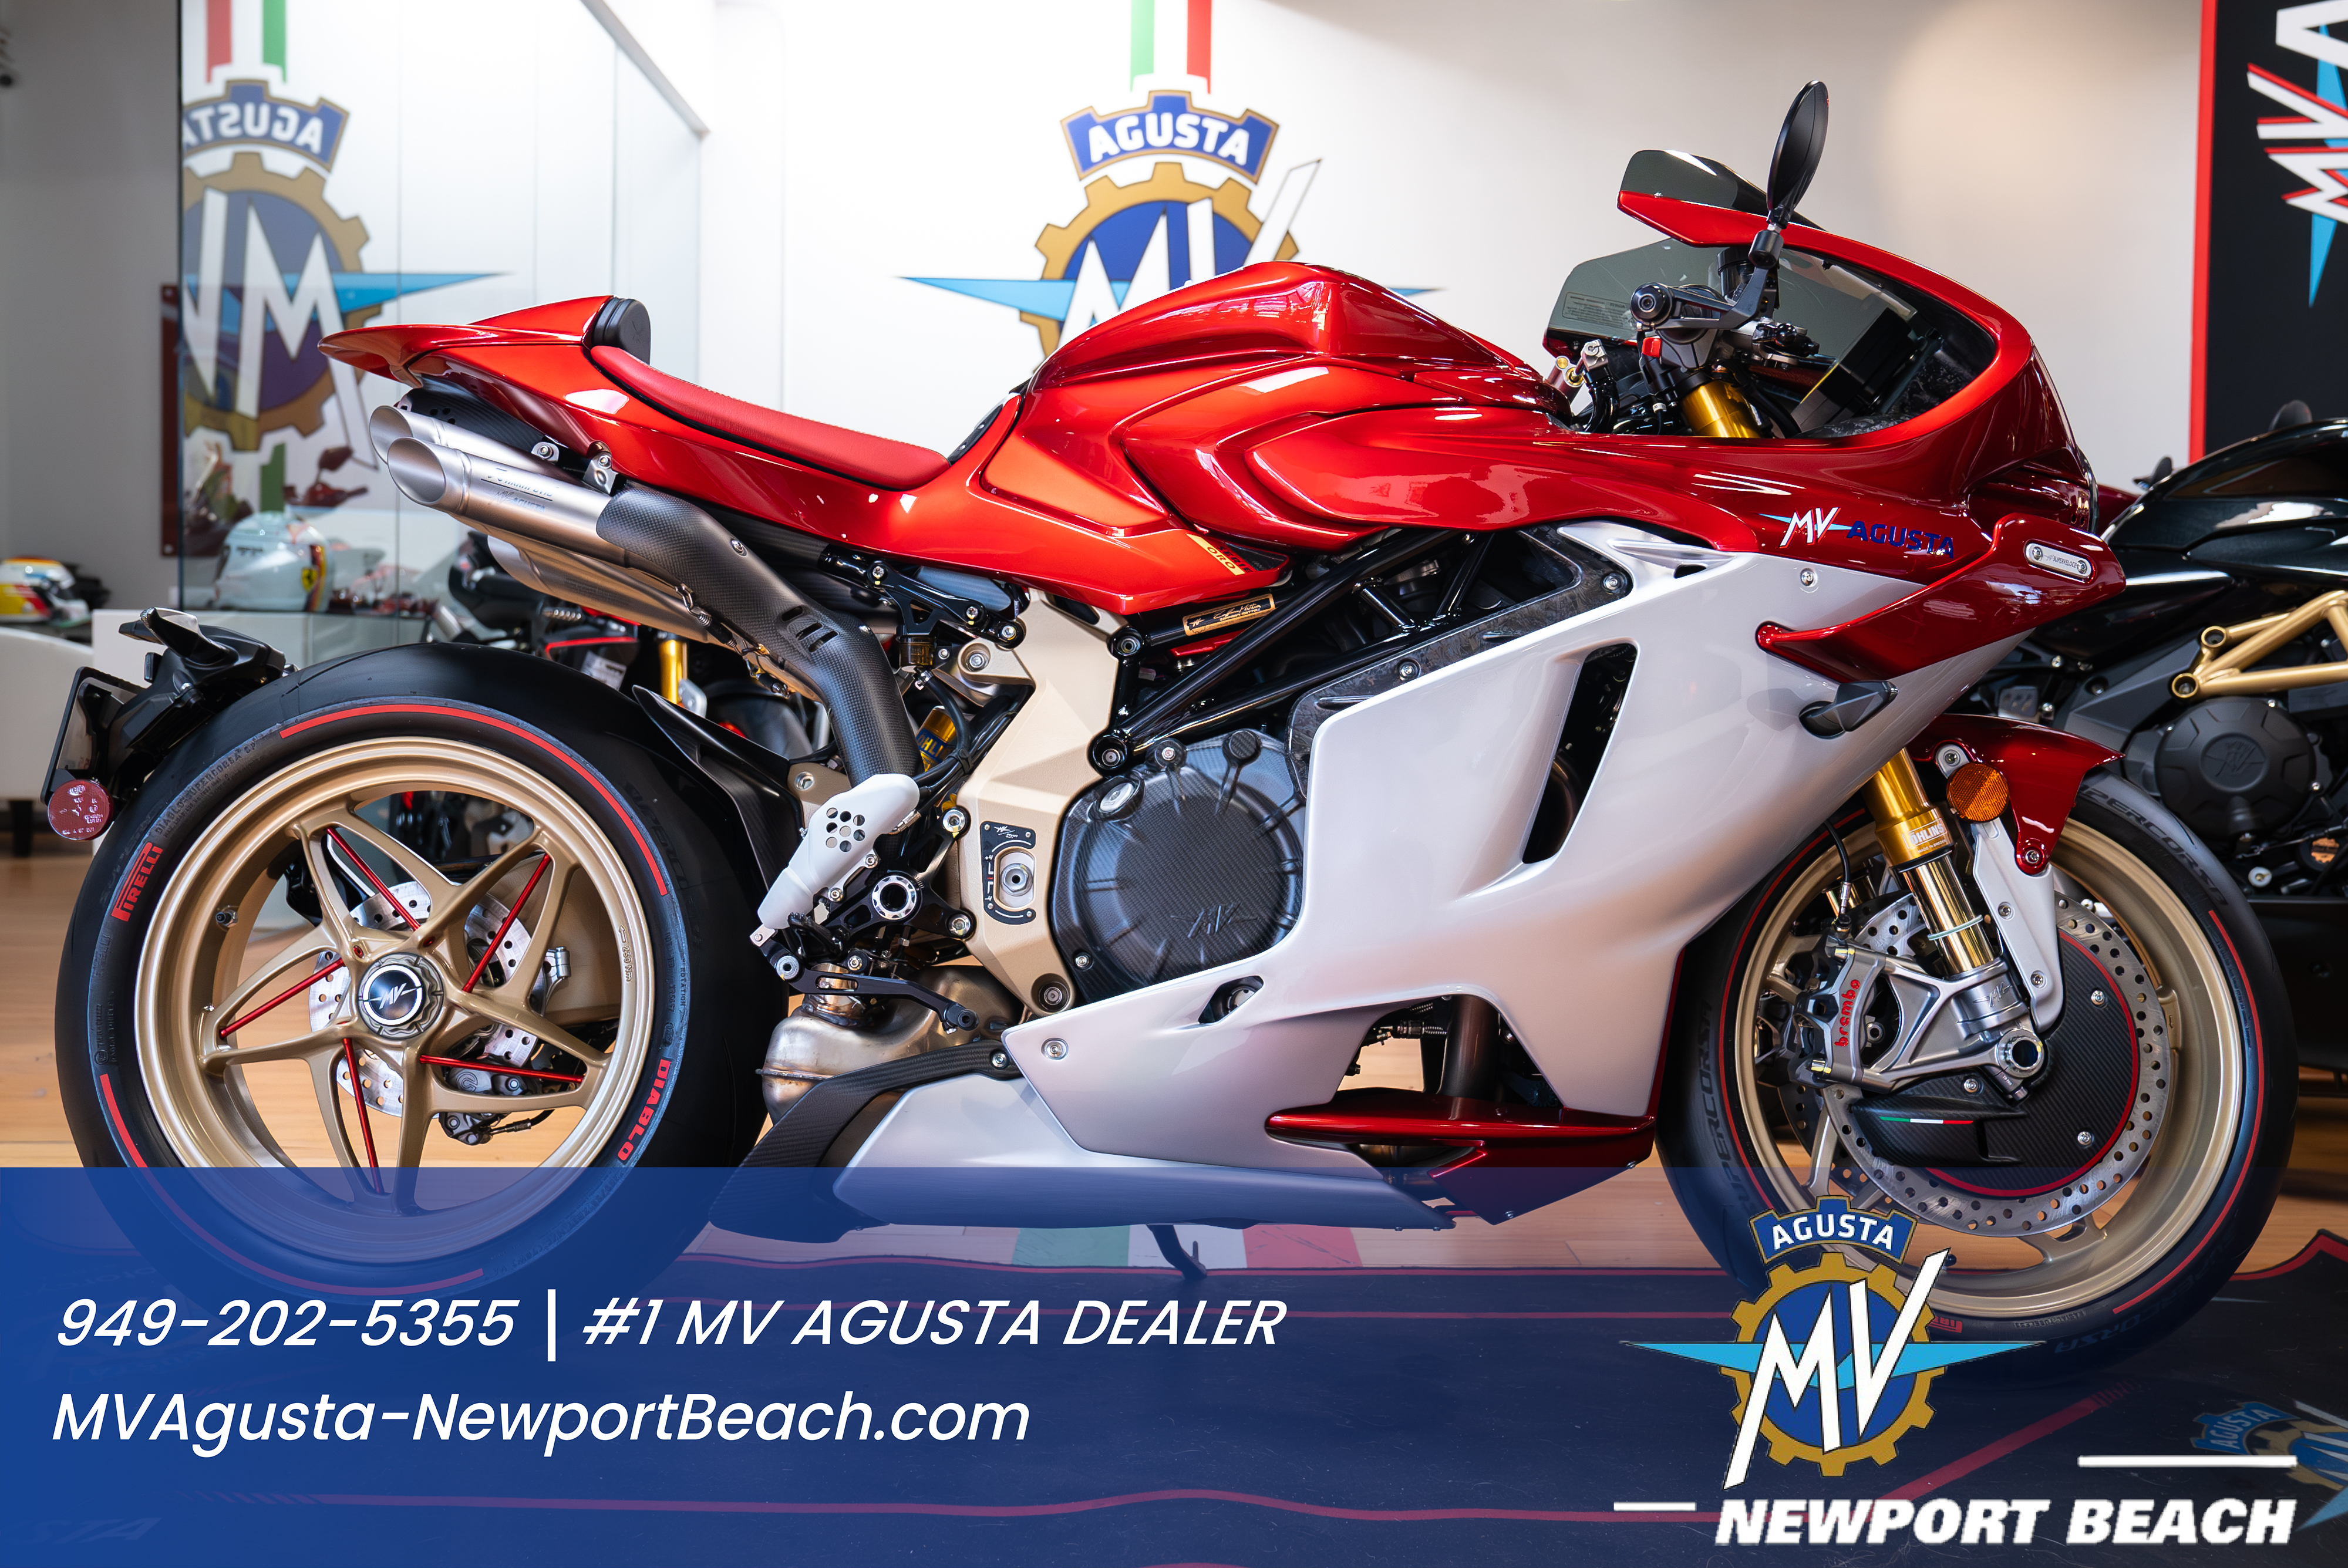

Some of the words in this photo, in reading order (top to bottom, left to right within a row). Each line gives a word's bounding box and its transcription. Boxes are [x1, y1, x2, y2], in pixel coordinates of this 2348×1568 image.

[1087, 112, 1250, 166] AGUSTA
[1779, 507, 1841, 549] MV
[1847, 520, 1956, 559] AGUSTA
[1207, 547, 1235, 569] ORO
[1219, 545, 1254, 573] SERIE
[2053, 555, 2078, 568] SUPERVELOCE
[111, 841, 163, 922] PIRELLI
[622, 946, 632, 963] 250
[376, 982, 410, 1010] MV
[1834, 979, 1861, 1047] brembo
[618, 1058, 672, 1161] DIABLO
[2209, 1408, 2282, 1450] AGUSTA
